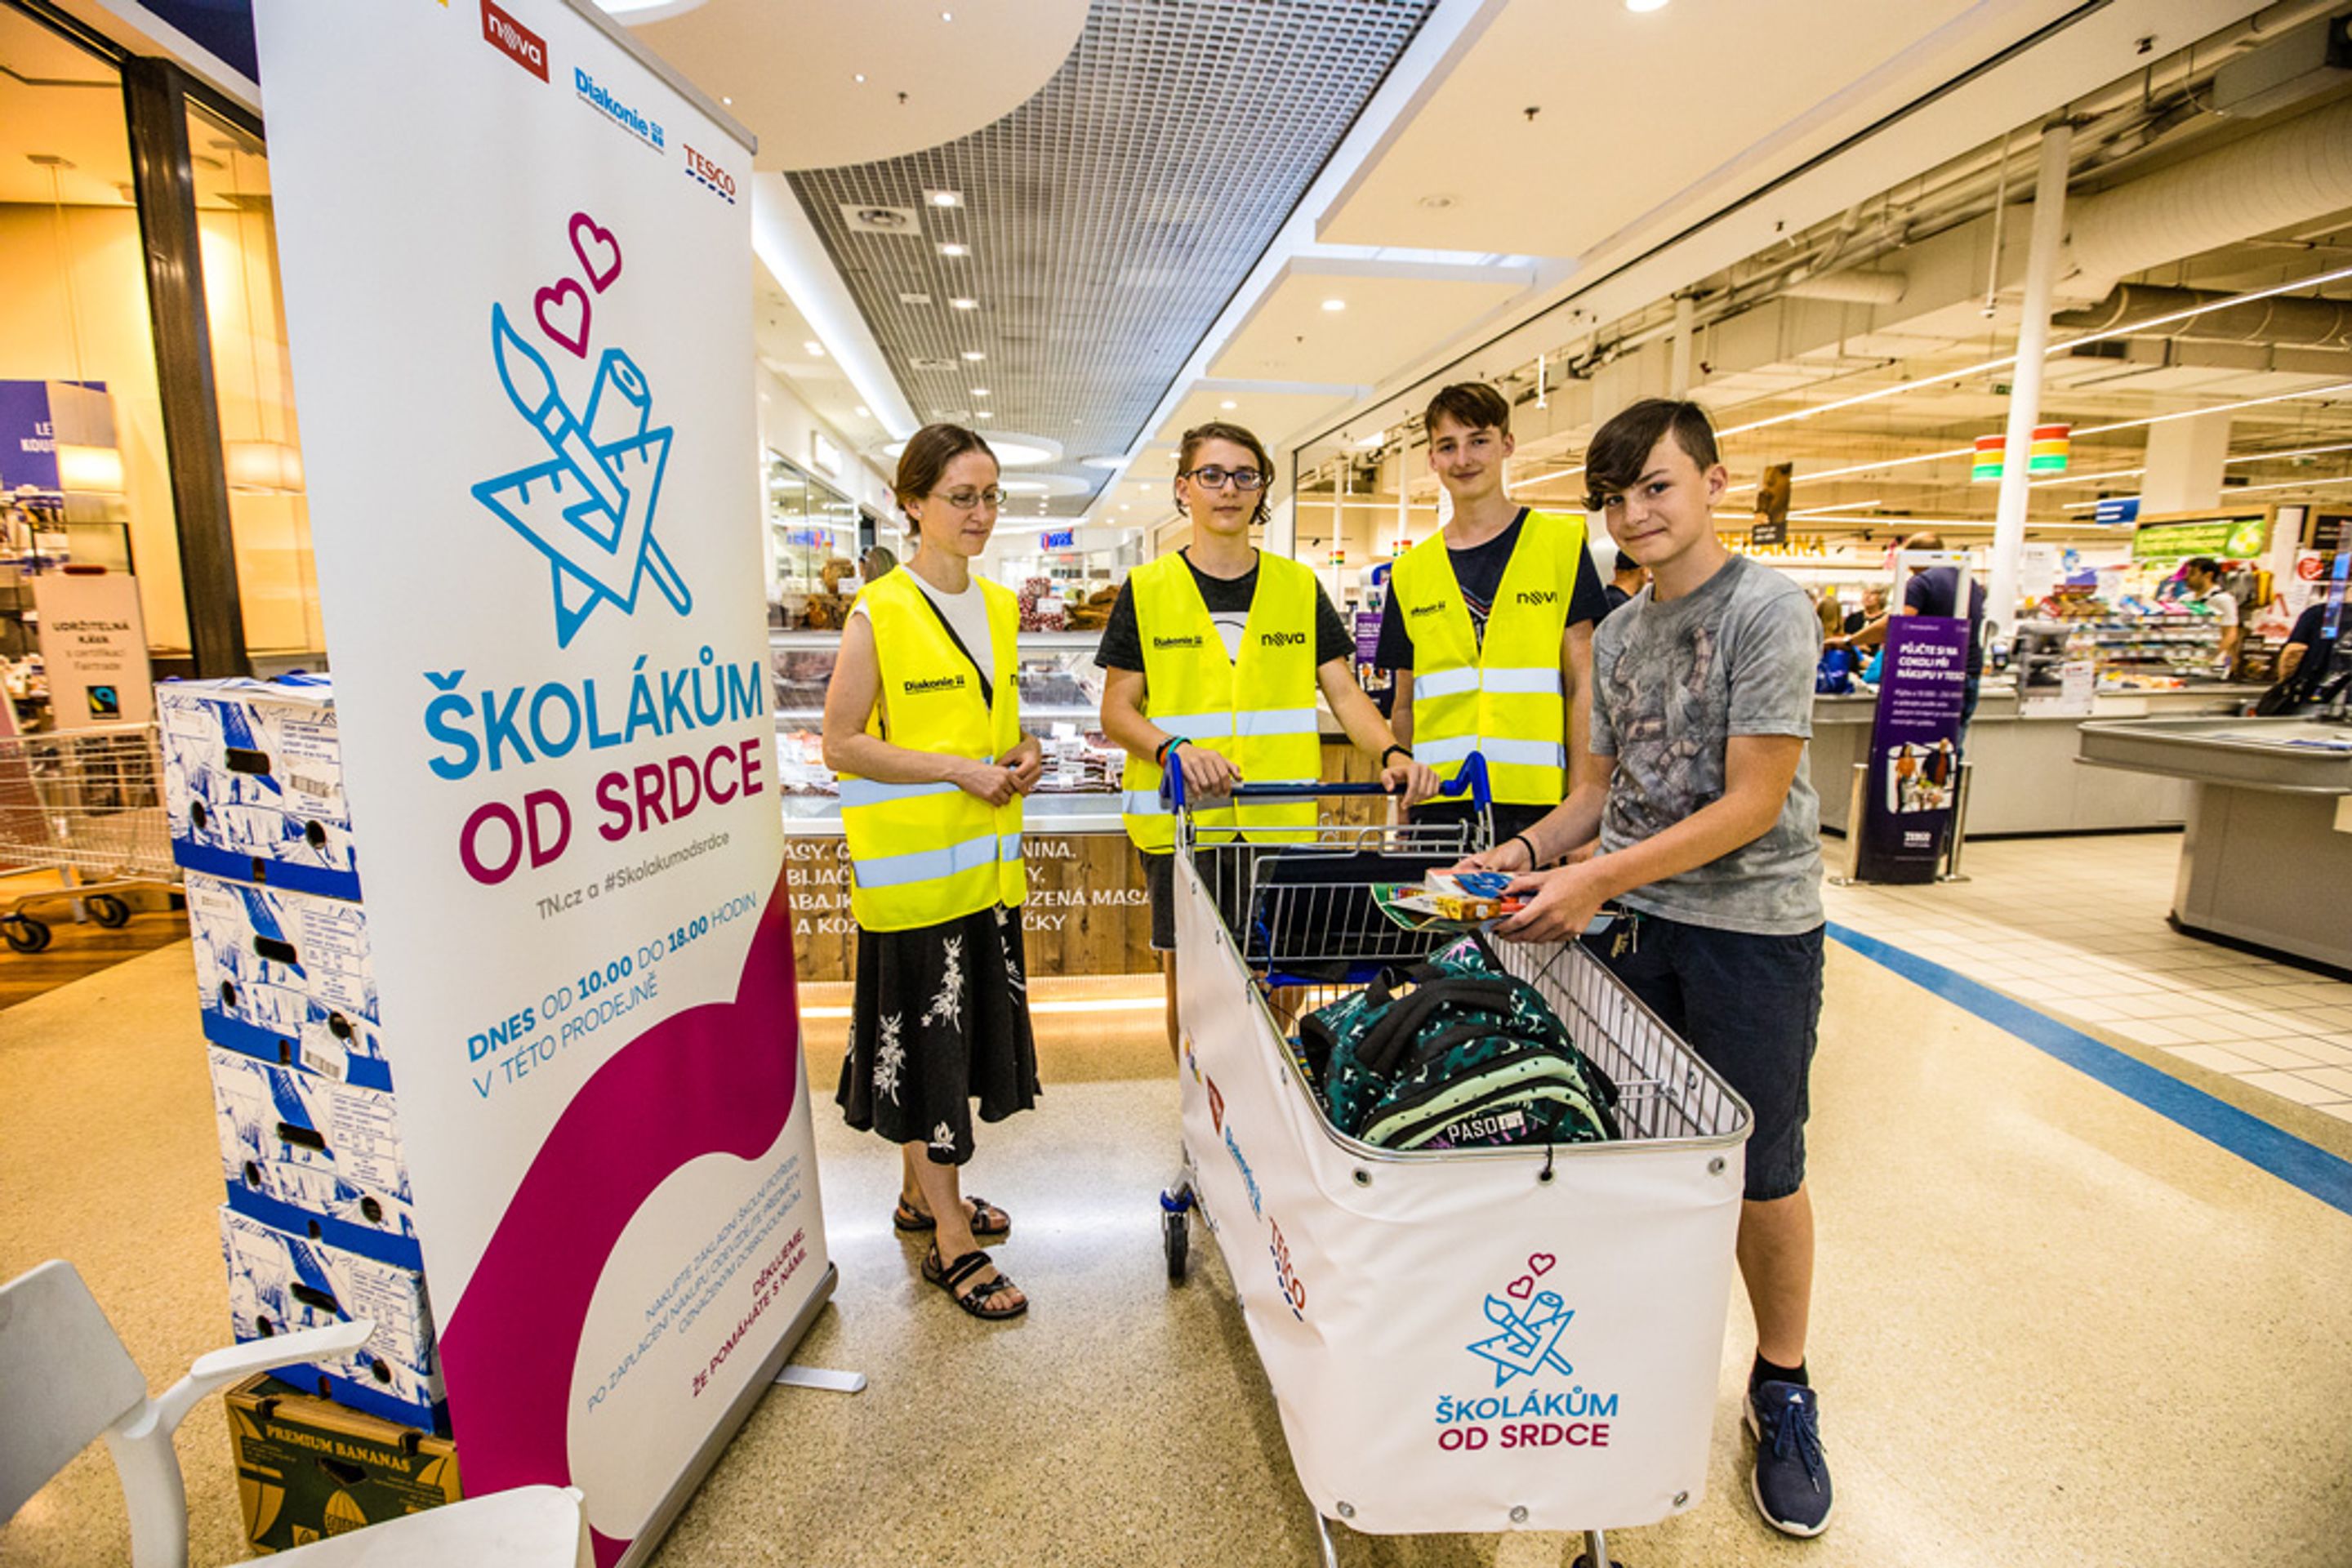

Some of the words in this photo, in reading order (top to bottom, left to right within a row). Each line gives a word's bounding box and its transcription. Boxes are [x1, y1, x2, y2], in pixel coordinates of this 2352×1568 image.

[488, 13, 541, 66] nova
[575, 67, 649, 137] Diakonie
[683, 144, 736, 196] TESCO
[1261, 632, 1307, 646] nova
[904, 676, 955, 691] Diakonie
[423, 645, 764, 781] ŠKOLÁKŮM
[460, 788, 572, 885] OD
[595, 737, 764, 841] SRDCE
[536, 889, 583, 920] TN.cz
[587, 883, 599, 899] a
[466, 1007, 537, 1062] DNES
[541, 986, 572, 1021] OD
[577, 955, 633, 1000] 10.00
[638, 939, 664, 970] DO
[667, 915, 709, 954] 18.00
[711, 891, 757, 929] HODIN
[472, 1070, 492, 1098] V
[500, 1035, 556, 1085] TÉTO
[561, 971, 658, 1049] PRODEJNĚ
[693, 1369, 708, 1398] ŽE
[710, 1290, 770, 1374] POMÁHÁTE
[1435, 1385, 1619, 1424] ŠKOLÁKŮM
[266, 1424, 332, 1453] PREMIUM
[336, 1442, 412, 1472] BANANAS
[1438, 1427, 1489, 1450] OD
[1500, 1423, 1610, 1448] SRDCE
